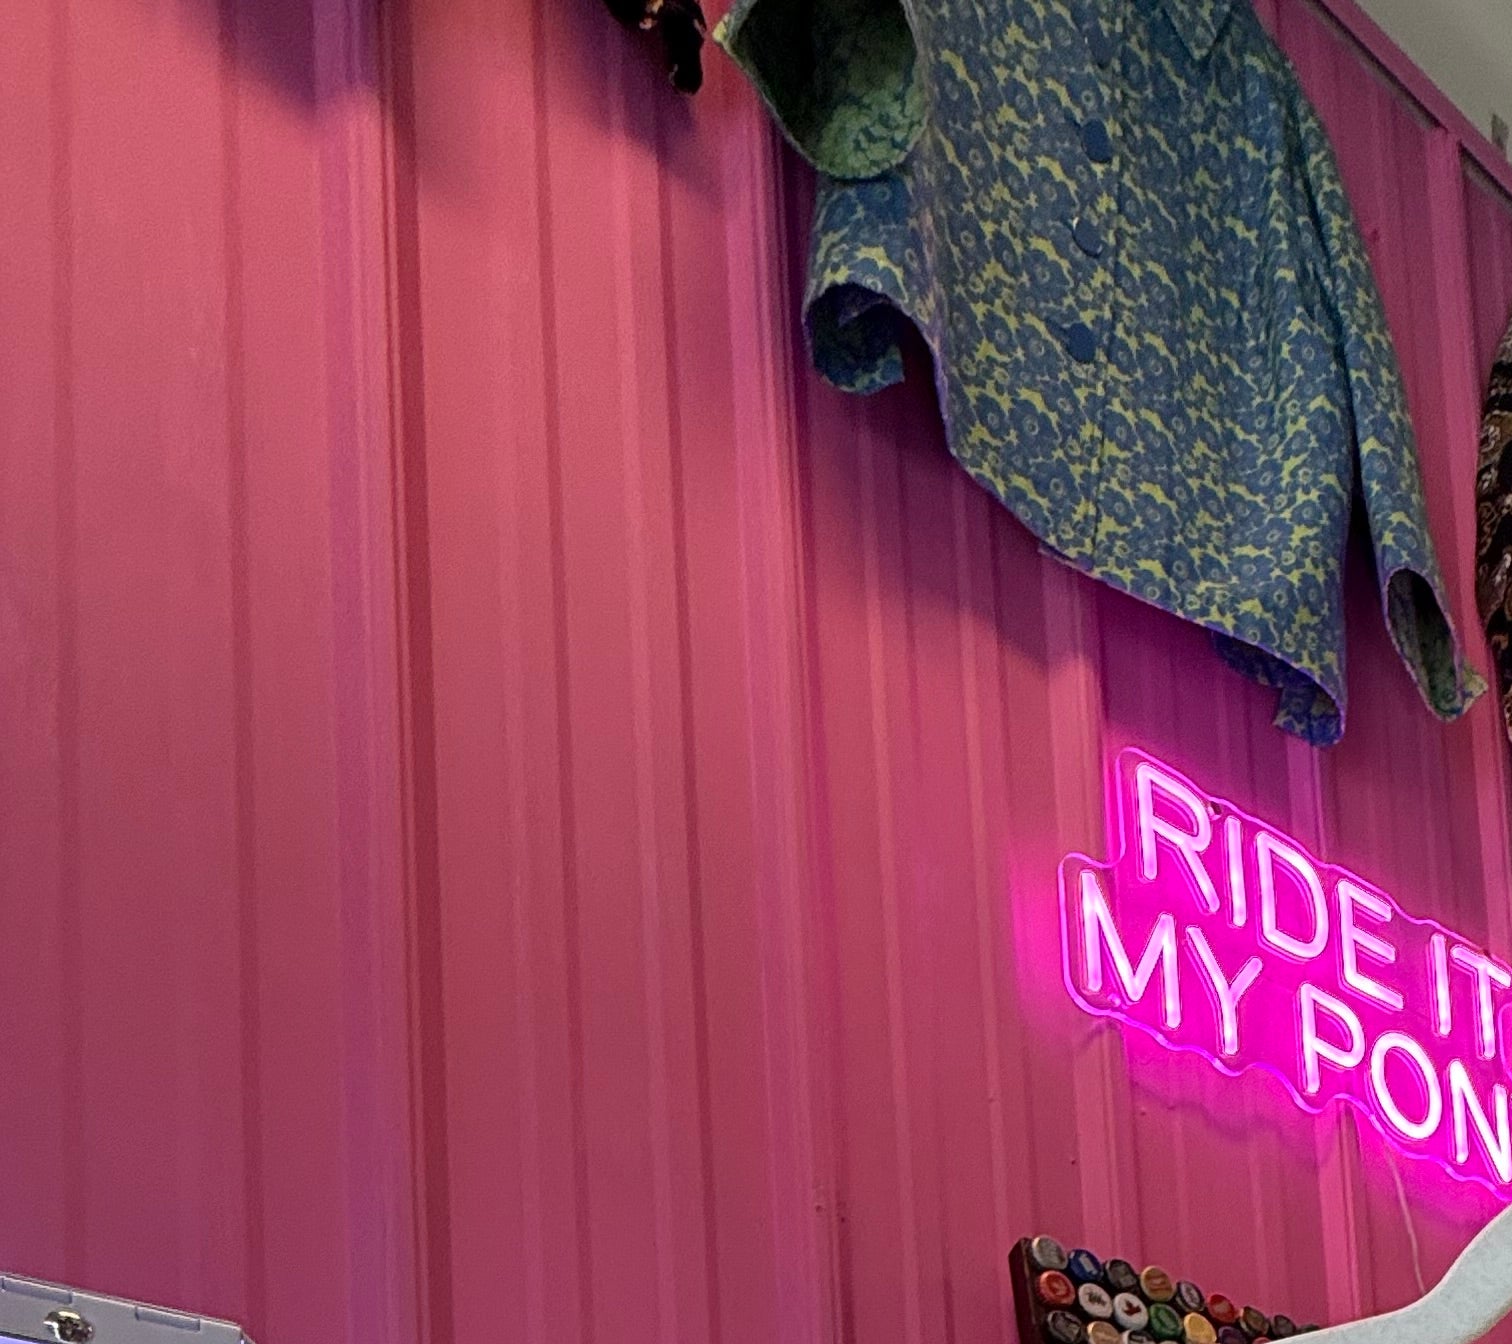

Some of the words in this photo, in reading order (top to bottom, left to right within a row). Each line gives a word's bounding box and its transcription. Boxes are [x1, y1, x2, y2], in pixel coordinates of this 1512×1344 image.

[1081, 870, 1263, 1055] MY
[1136, 762, 1404, 1011] RIDE
[1430, 934, 1511, 1059] IT
